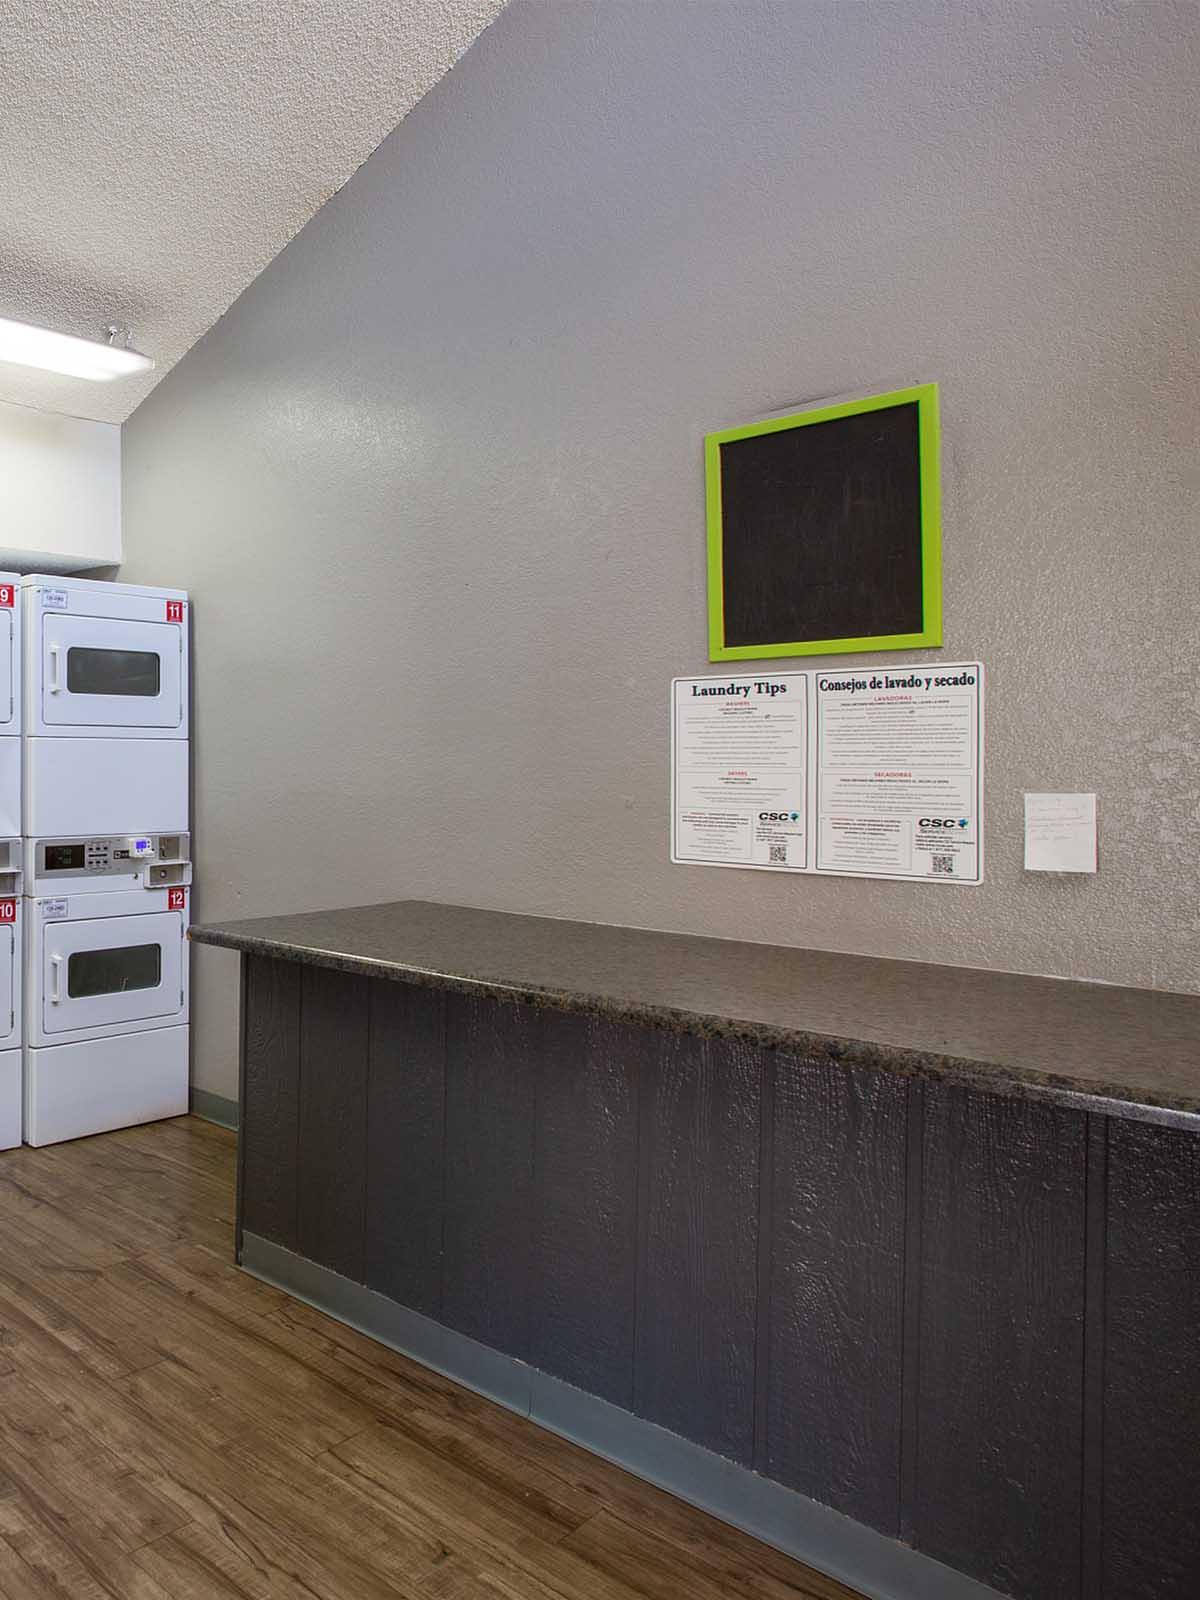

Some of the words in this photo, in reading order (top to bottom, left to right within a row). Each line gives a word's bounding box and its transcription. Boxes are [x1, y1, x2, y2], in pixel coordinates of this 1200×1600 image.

[0, 589, 9, 602] 9
[168, 606, 179, 618] 11
[819, 678, 867, 693] Consejos
[869, 676, 883, 689] de
[885, 674, 922, 689] lavado
[924, 677, 933, 690] y
[934, 672, 975, 687] secado
[692, 683, 751, 698] Laundry
[754, 682, 787, 697] Tips
[759, 812, 789, 821] CSC
[918, 818, 956, 828] CSC
[170, 892, 183, 905] 12
[0, 903, 13, 918] 10
